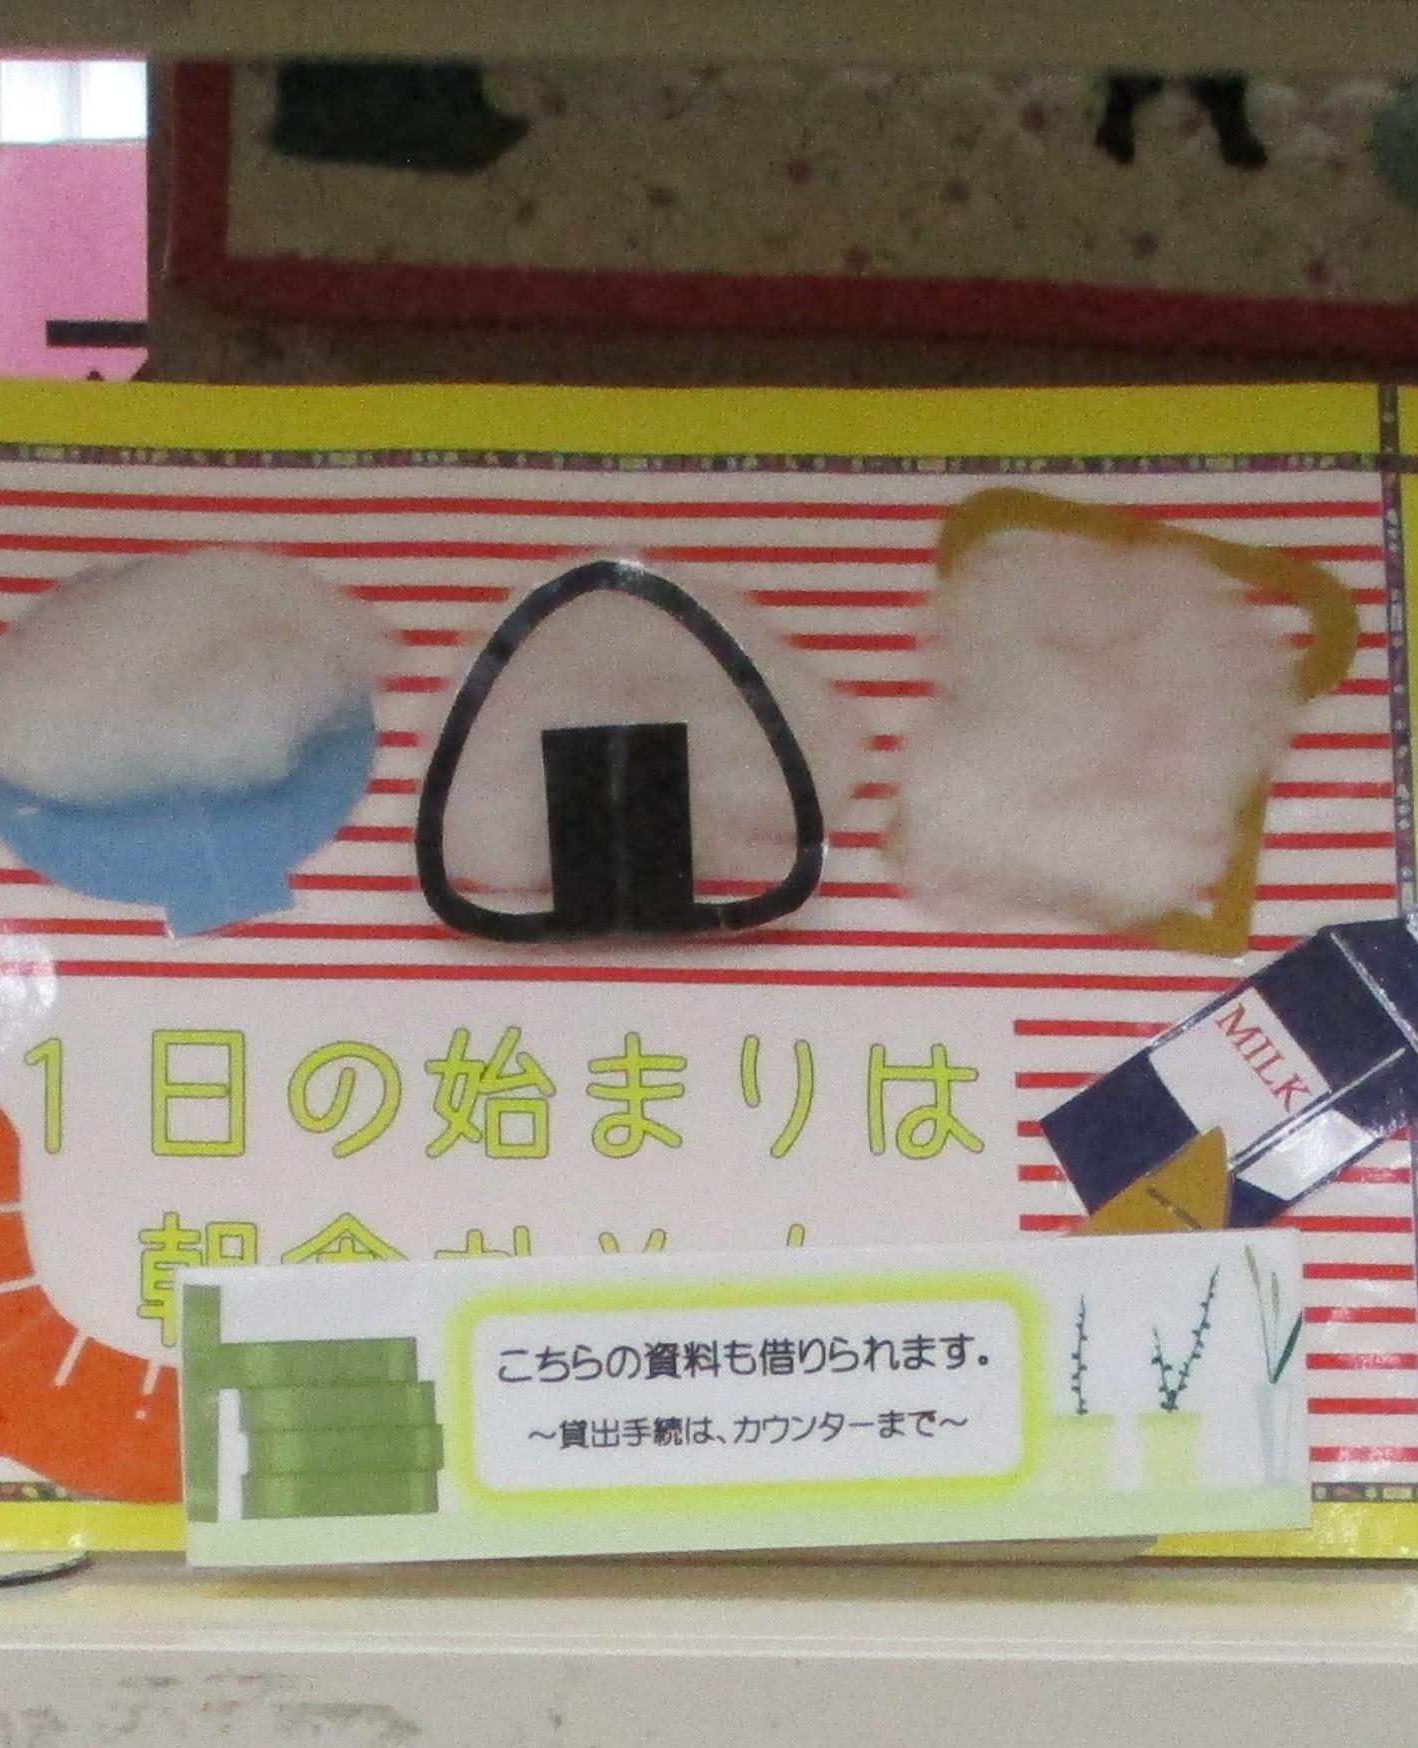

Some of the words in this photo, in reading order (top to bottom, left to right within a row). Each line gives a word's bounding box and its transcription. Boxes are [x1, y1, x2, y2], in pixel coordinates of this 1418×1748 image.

[25, 1026, 985, 1161] 1日の始まりは
[1214, 1000, 1311, 1113] MILK
[496, 1333, 992, 1384] こちらの資料も借りられます。
